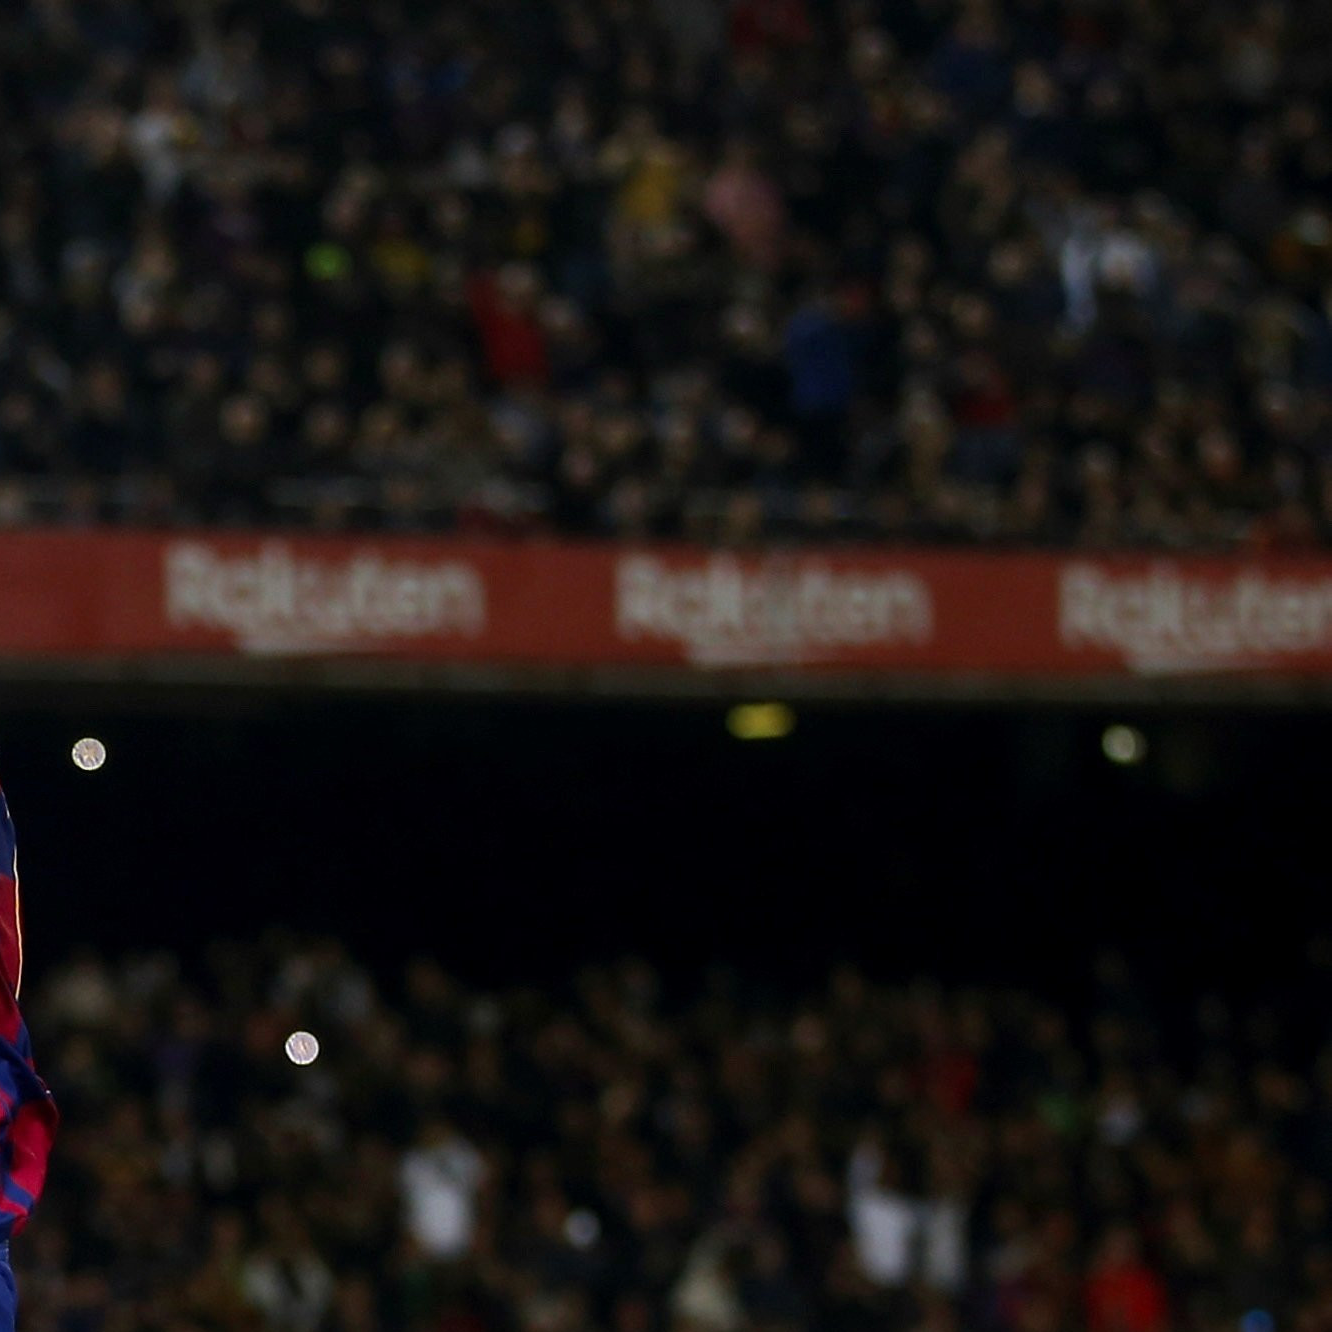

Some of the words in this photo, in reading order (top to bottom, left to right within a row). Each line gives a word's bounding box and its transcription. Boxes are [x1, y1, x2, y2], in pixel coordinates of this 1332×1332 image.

[164, 540, 487, 637] Rakuten
[613, 551, 932, 646] Rakuten
[1059, 560, 1332, 655] Rakute
